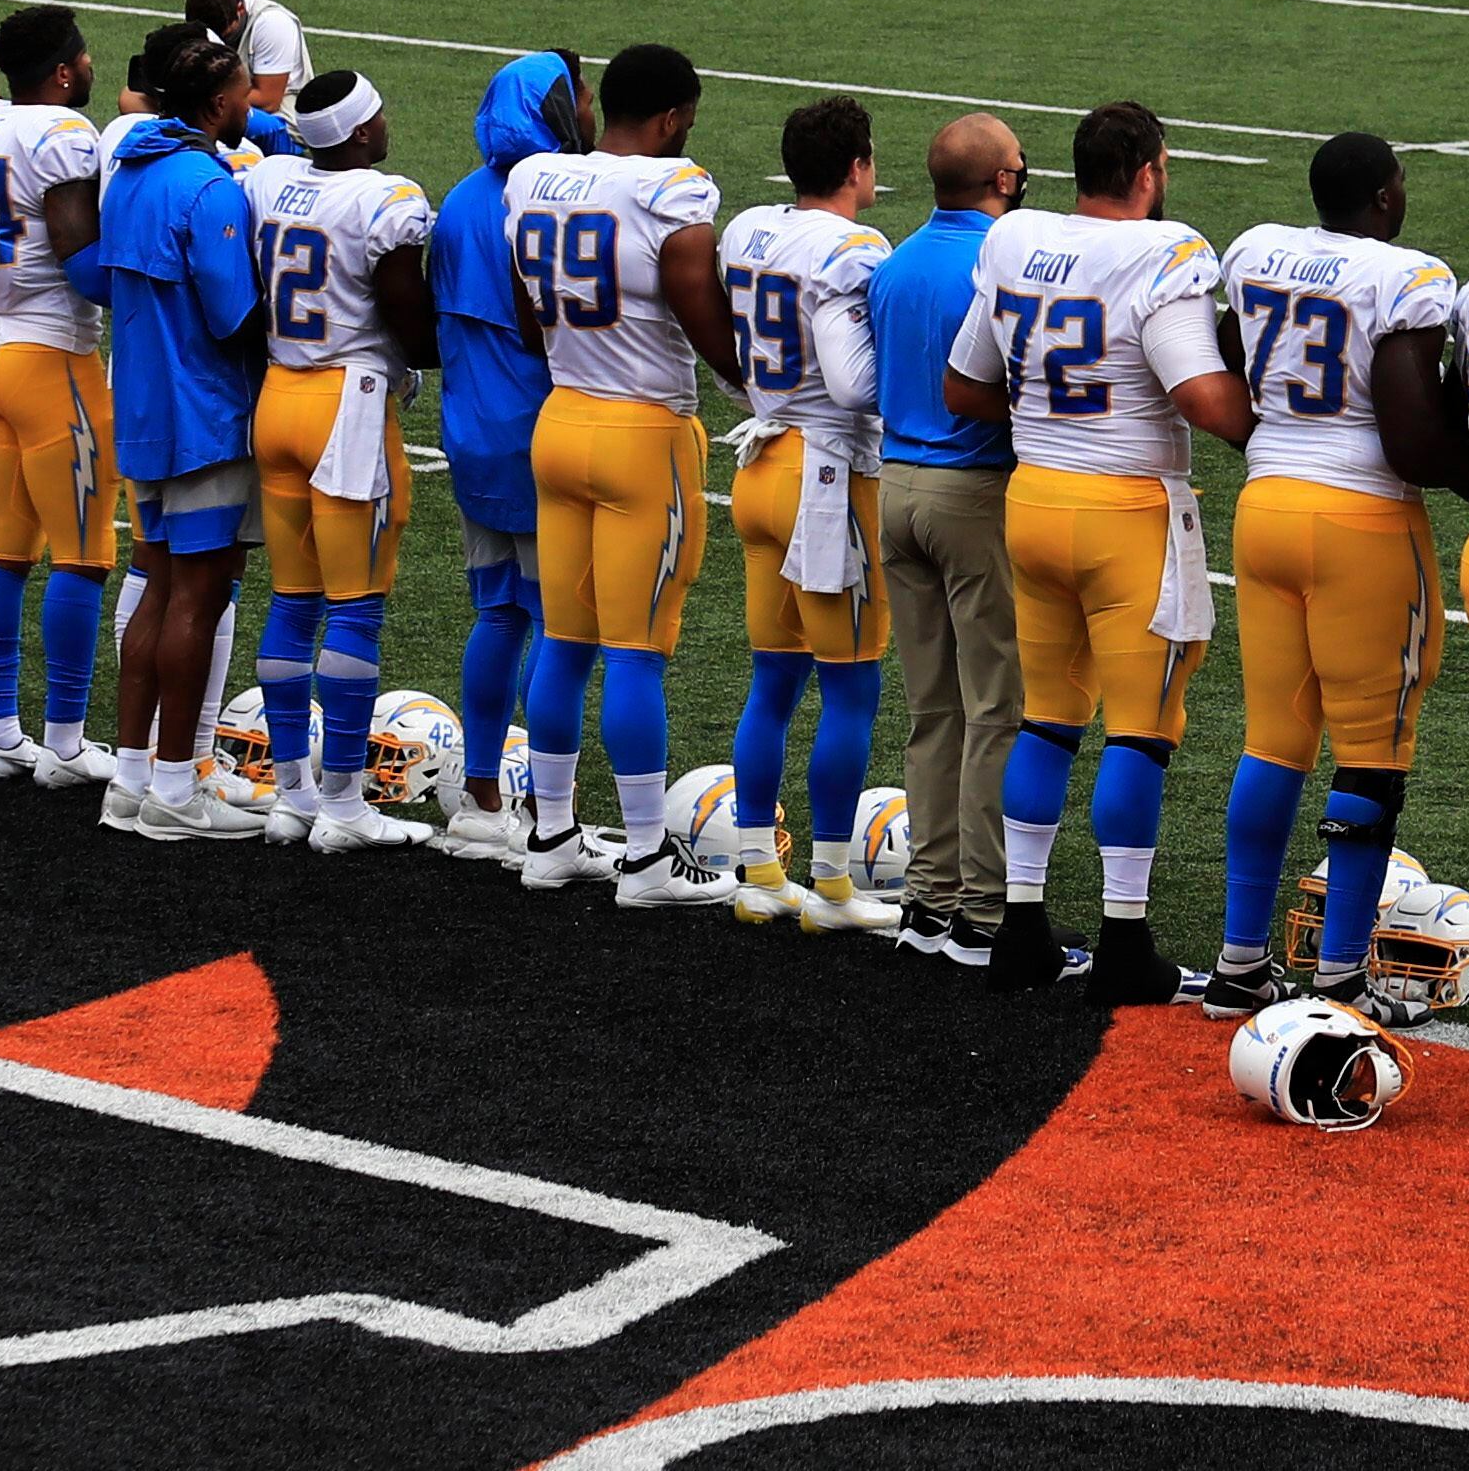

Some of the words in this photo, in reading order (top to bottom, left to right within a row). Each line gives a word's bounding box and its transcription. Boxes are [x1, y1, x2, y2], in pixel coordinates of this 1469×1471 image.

[273, 184, 319, 218] REED
[257, 219, 330, 343] 12
[515, 210, 622, 330] 99
[1022, 248, 1081, 286] GROY
[1260, 248, 1290, 276] ST
[1288, 255, 1349, 287] LOUIS
[724, 264, 806, 393] 59
[993, 285, 1113, 418] 72
[1241, 280, 1350, 417] 73
[428, 722, 455, 749] 42
